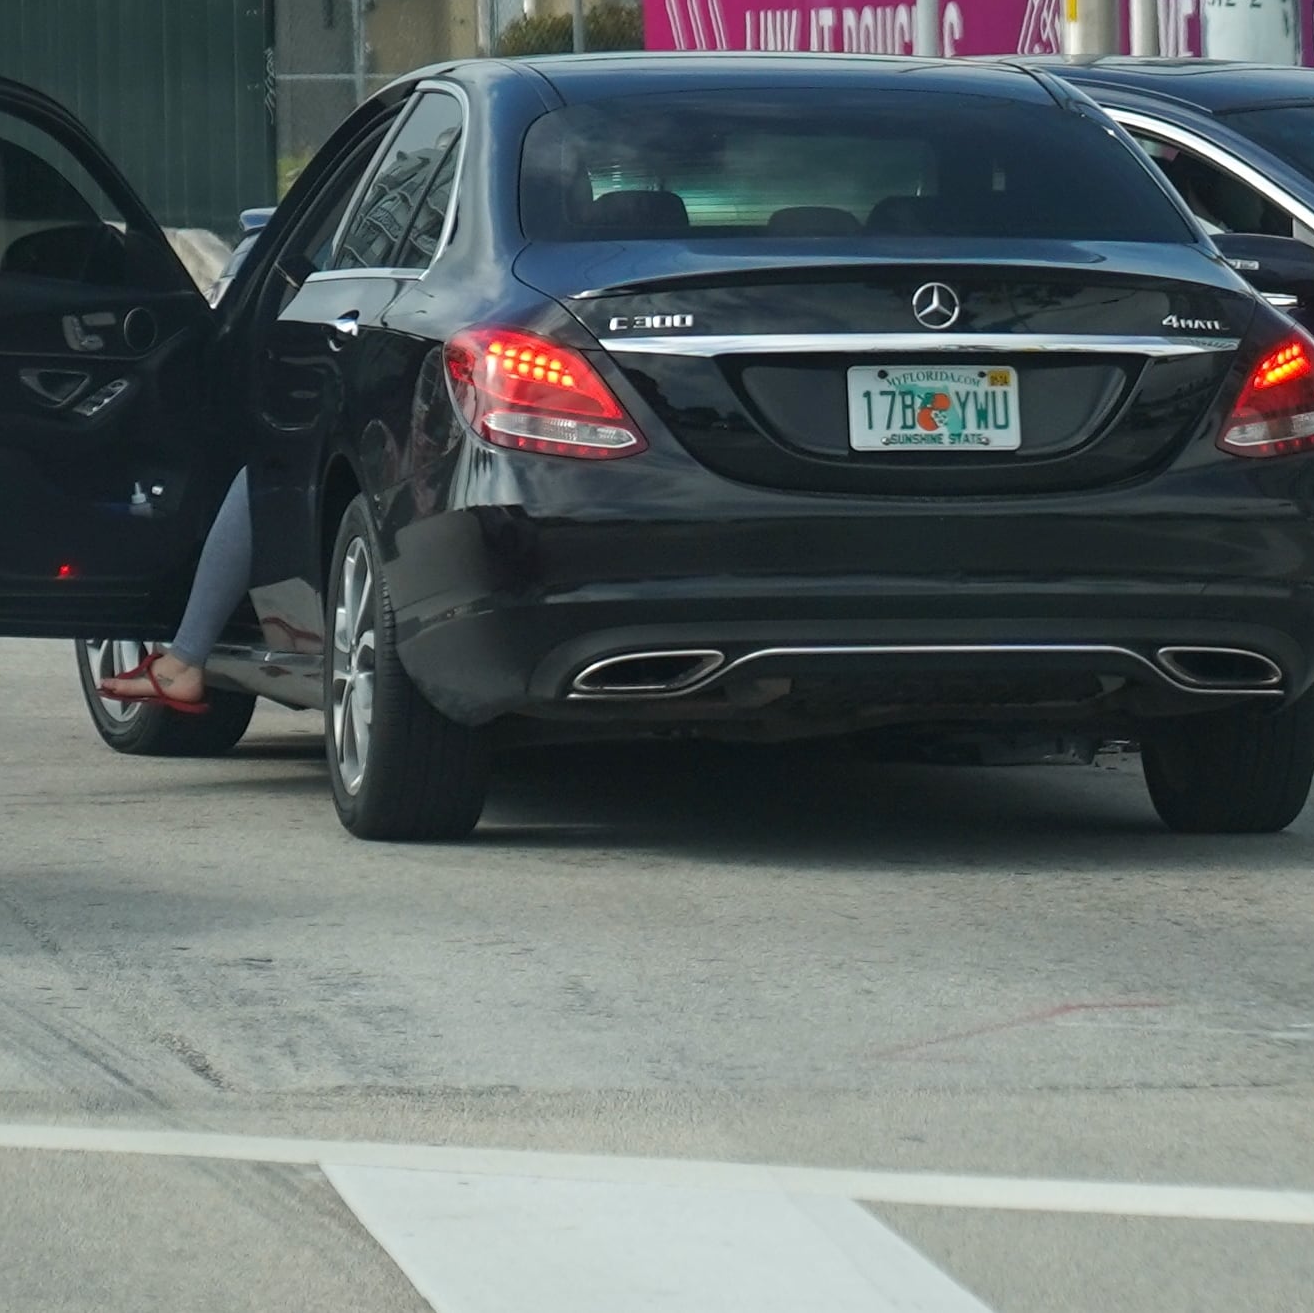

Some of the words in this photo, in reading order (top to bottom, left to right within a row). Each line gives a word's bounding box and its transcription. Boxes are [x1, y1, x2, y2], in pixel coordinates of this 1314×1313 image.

[632, 314, 694, 329] 300
[886, 370, 981, 387] MYFLORIDA.COM
[862, 390, 916, 431] 17B
[955, 389, 1010, 430] YWU
[890, 433, 945, 445] SUNSHINE
